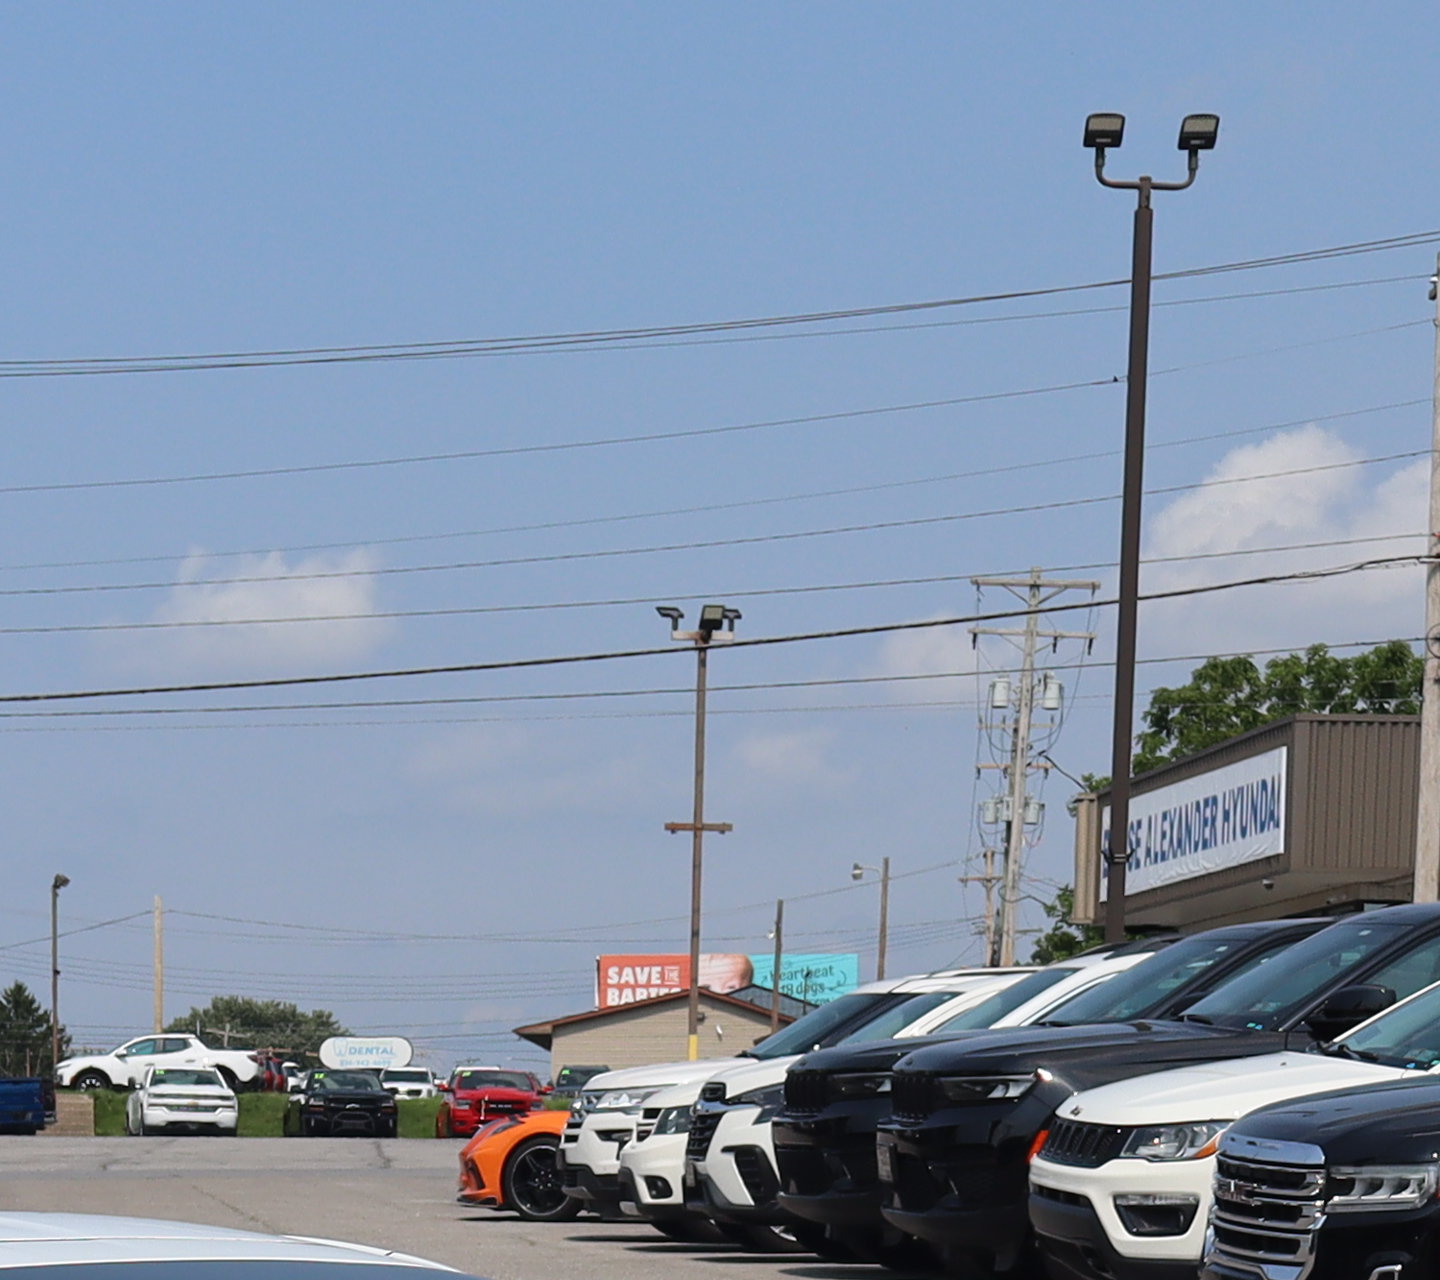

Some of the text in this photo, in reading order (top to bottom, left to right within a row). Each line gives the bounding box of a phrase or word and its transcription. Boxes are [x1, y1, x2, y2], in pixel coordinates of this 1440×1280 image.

[1144, 795, 1219, 867] ALEXANDER
[1221, 773, 1281, 845] HYUNDAI
[607, 965, 662, 985] SAVE
[348, 1046, 395, 1055] DENTAL
